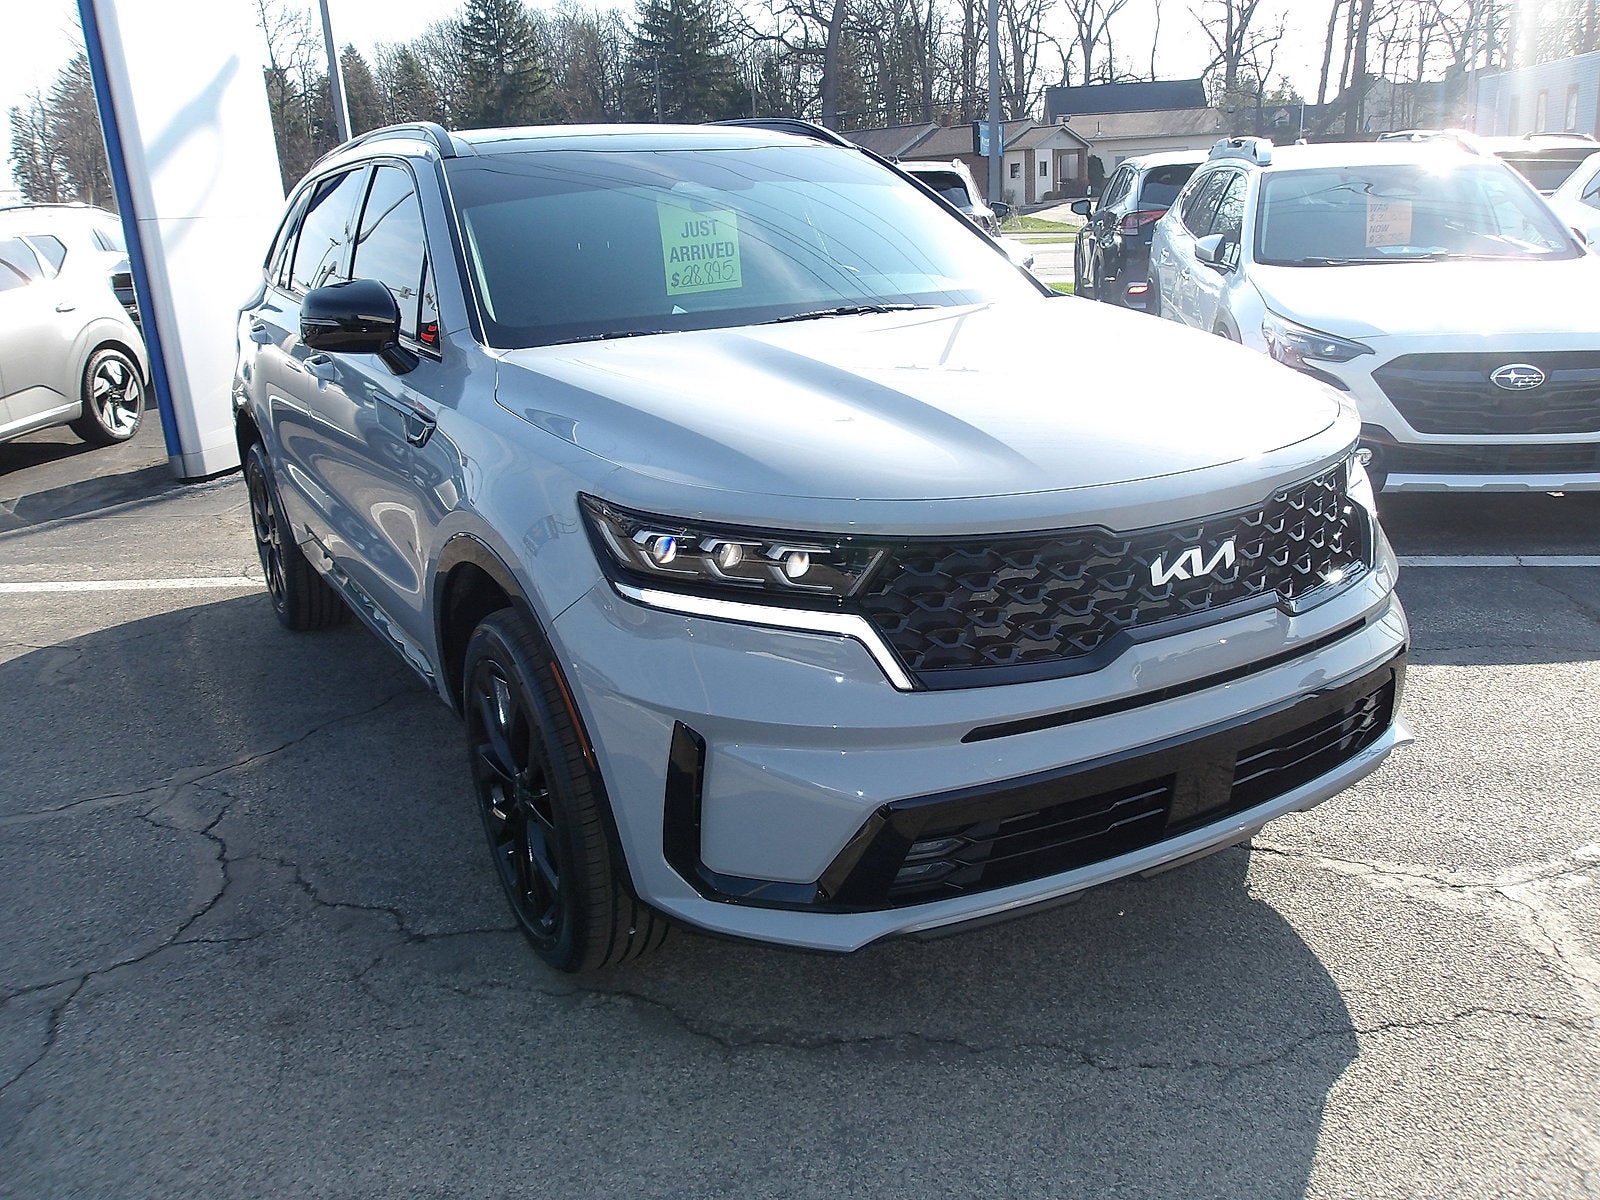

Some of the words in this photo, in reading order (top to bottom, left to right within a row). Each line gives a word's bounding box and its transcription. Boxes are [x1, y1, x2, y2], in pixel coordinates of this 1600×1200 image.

[681, 219, 718, 239] JUST
[1369, 224, 1390, 233] NOW
[669, 241, 735, 263] ARRIVED
[1150, 539, 1236, 587] KIA
